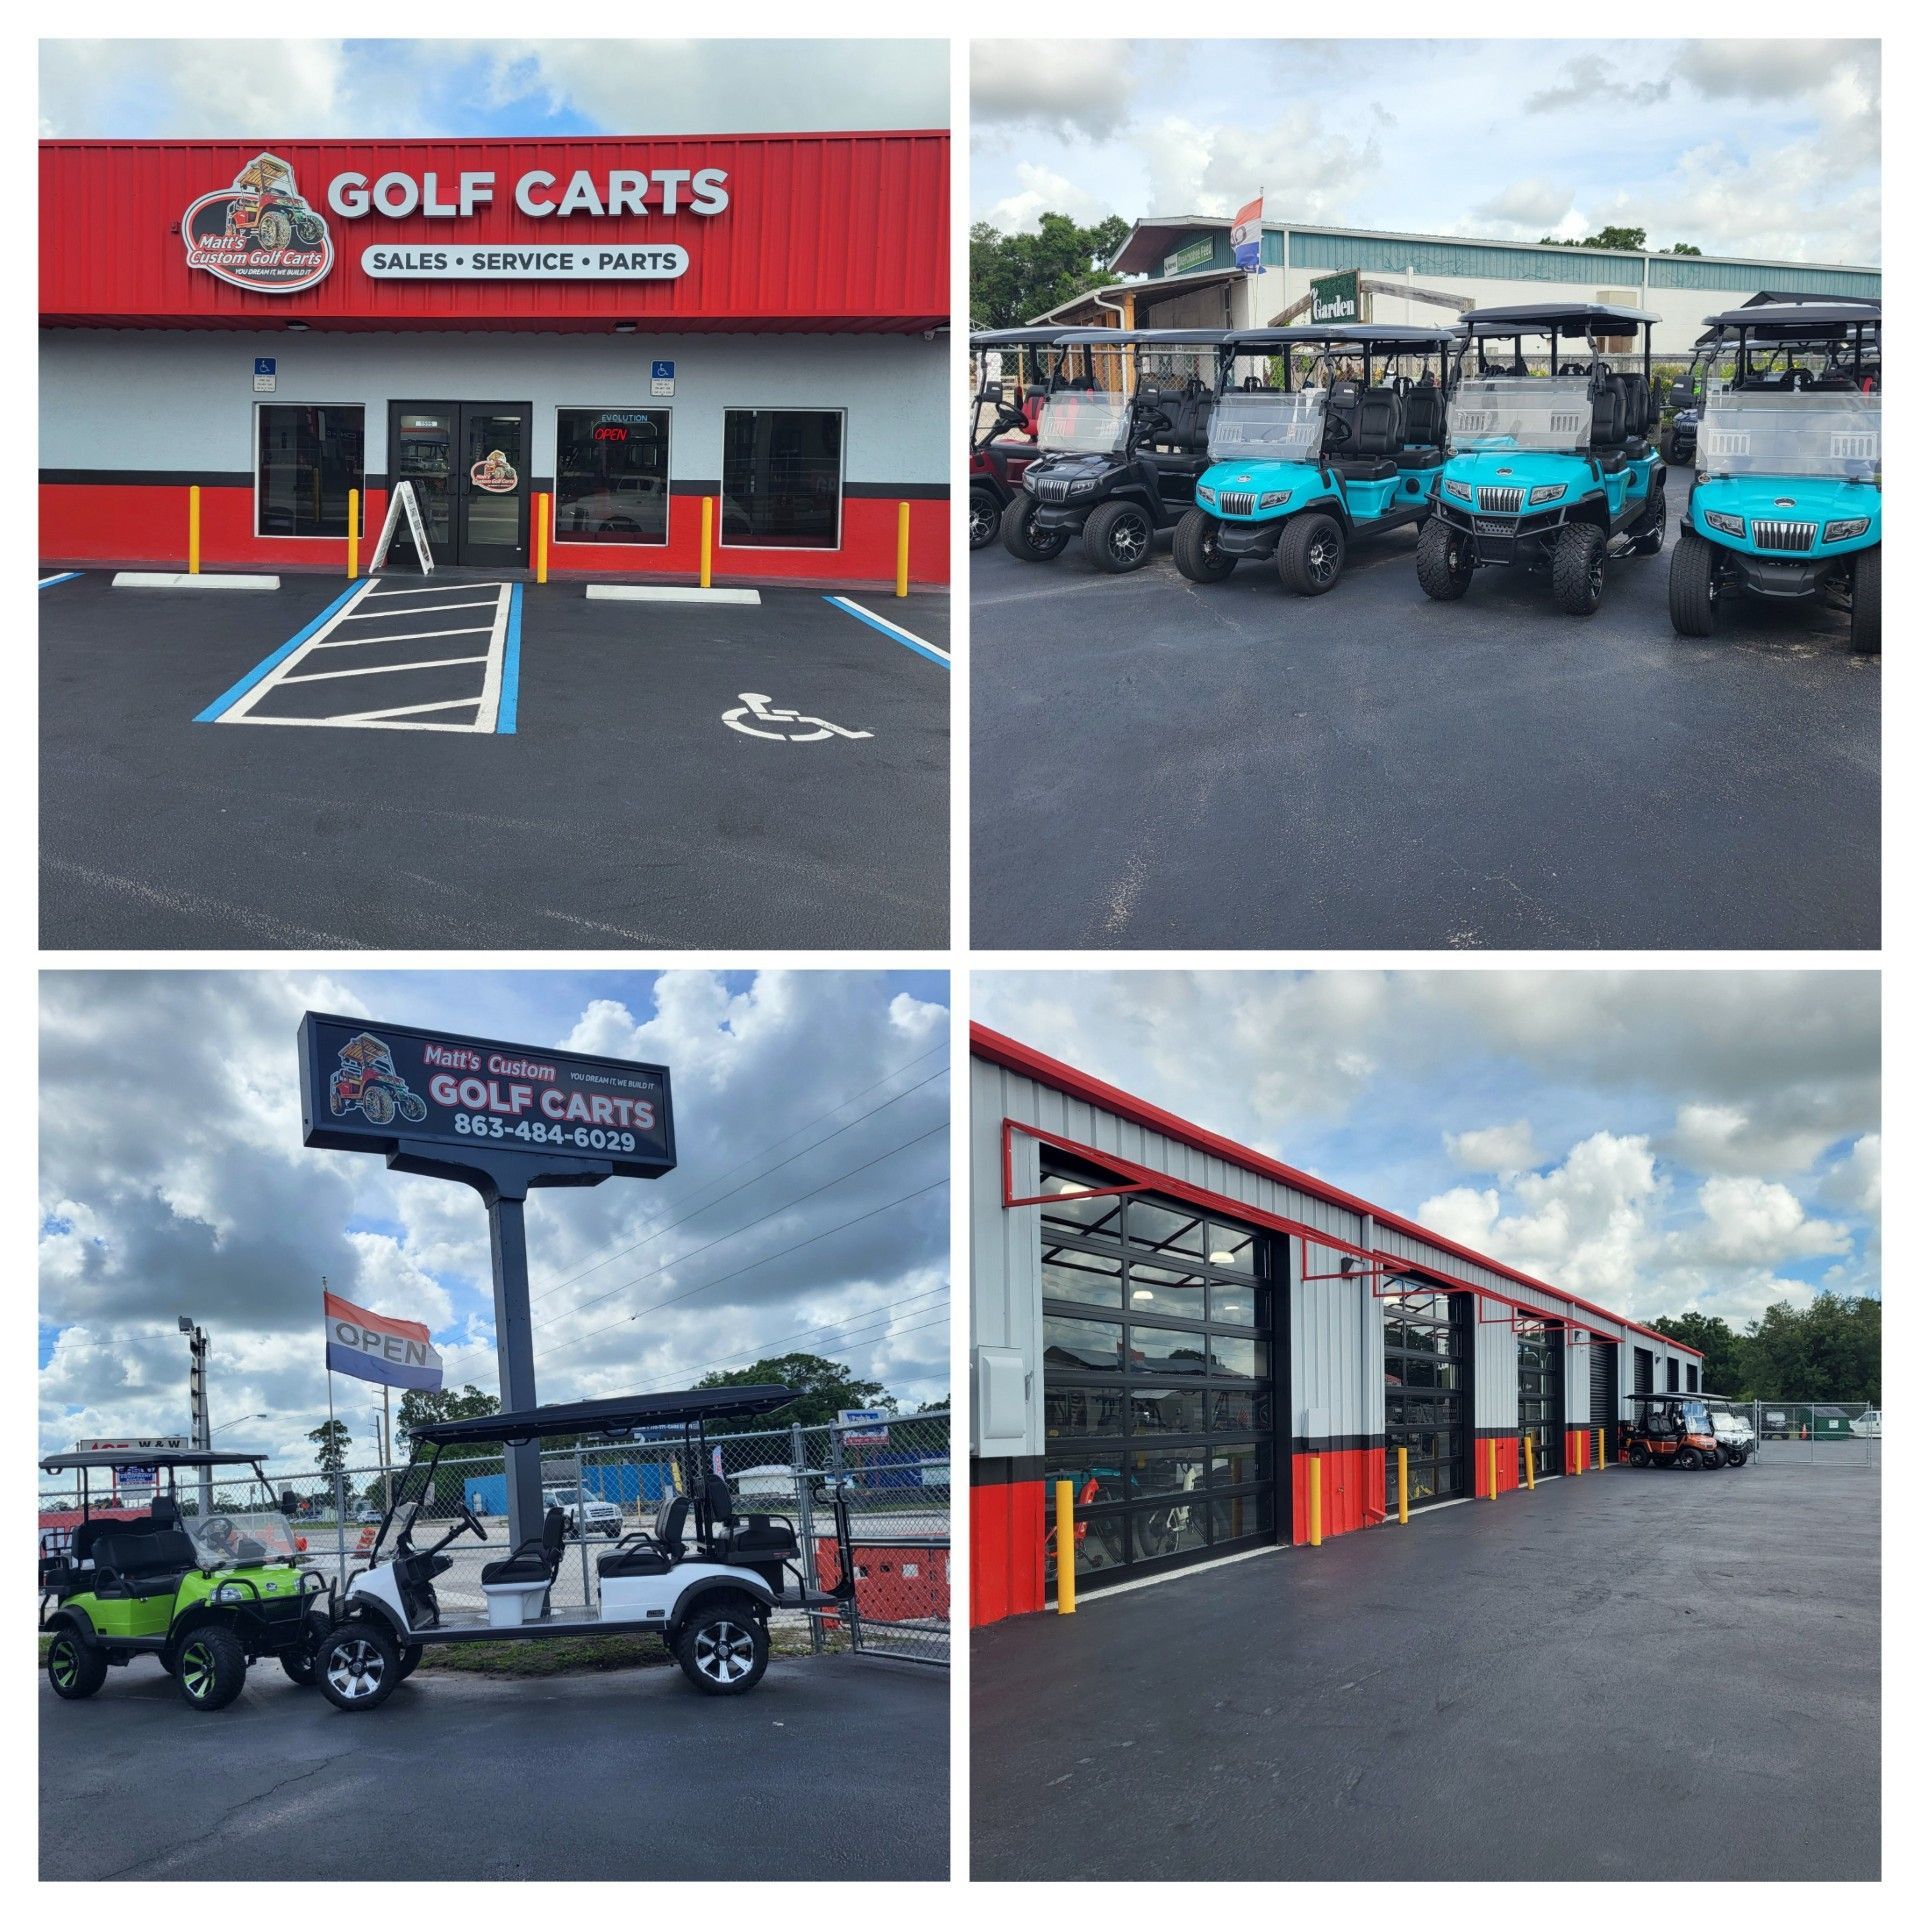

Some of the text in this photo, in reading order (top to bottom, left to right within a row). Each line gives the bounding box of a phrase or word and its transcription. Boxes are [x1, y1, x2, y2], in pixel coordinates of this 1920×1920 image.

[328, 168, 730, 218] GOLF CARTS
[199, 236, 245, 250] Matt's
[190, 250, 322, 265] Custom Golf Carts
[373, 252, 678, 271] SALES SERVICE PARTS
[248, 268, 270, 276] DREAM
[1313, 294, 1355, 320] Garden
[601, 414, 648, 422] EVOLUTION
[594, 428, 628, 441] OPEN
[424, 1045, 556, 1081] Matt's Custom
[570, 1072, 585, 1081] YOU
[585, 1074, 609, 1085] DREAM
[617, 1078, 628, 1087] WE
[627, 1080, 648, 1089] BUILD
[647, 1082, 655, 1090] IT
[430, 1073, 656, 1130] GOLF CARTS
[453, 1112, 637, 1153] 863-484-6029
[335, 1322, 427, 1366] OPEN
[138, 1440, 151, 1448] W
[168, 1440, 181, 1448] W
